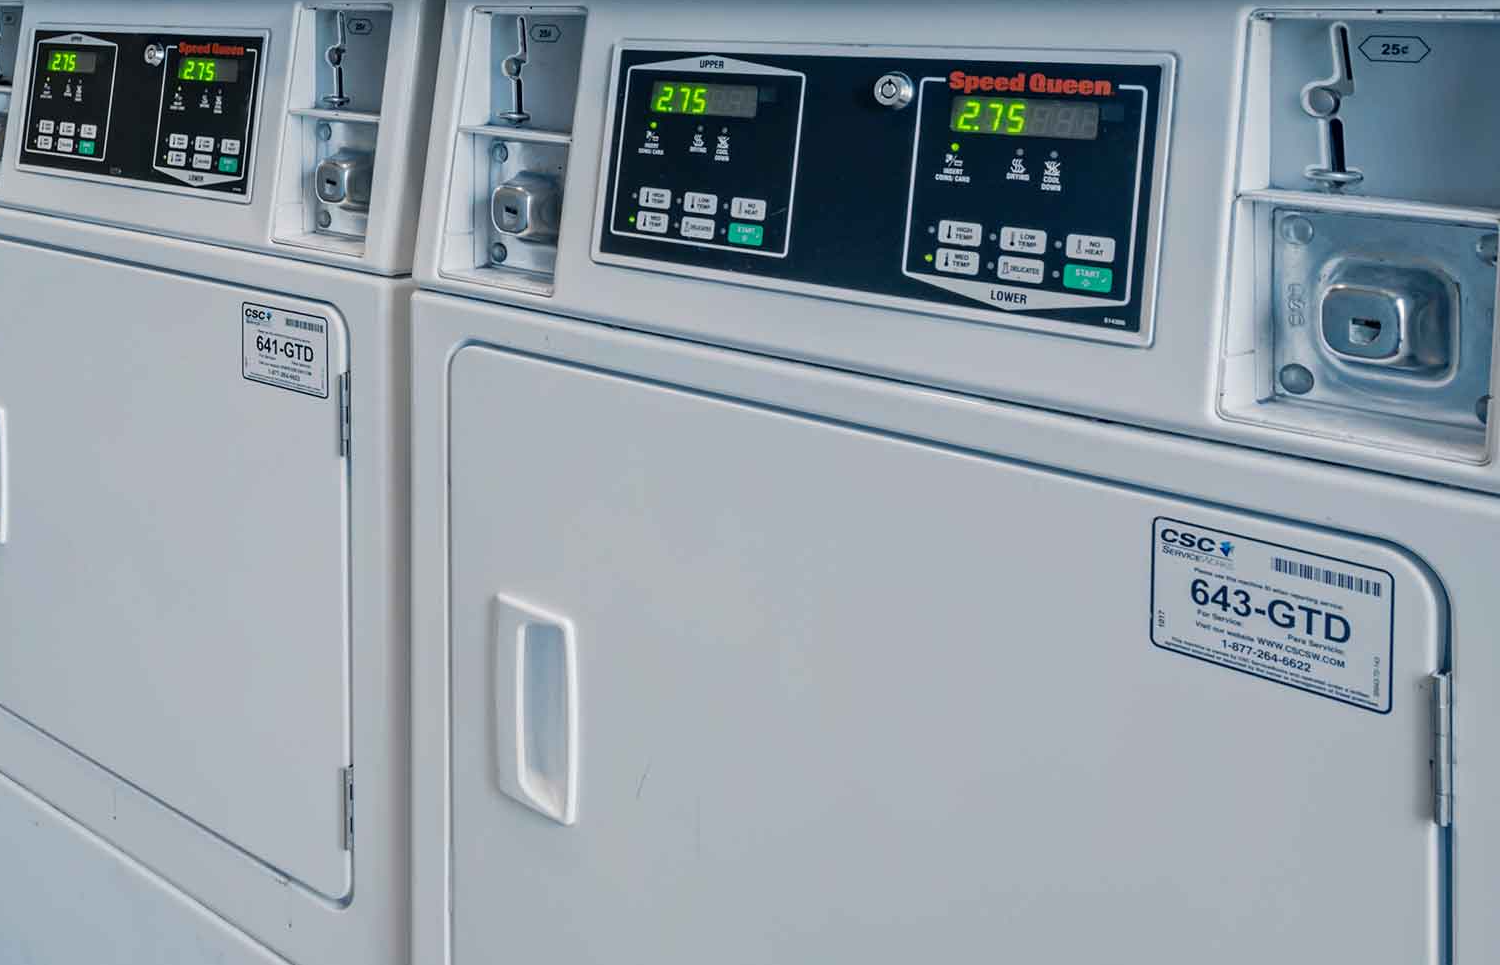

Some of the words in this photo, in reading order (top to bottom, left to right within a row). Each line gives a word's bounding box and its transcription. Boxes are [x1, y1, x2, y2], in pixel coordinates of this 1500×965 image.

[1381, 43, 1409, 56] 25¢
[183, 61, 216, 81] 2.75
[700, 60, 724, 69] UPPER
[949, 71, 1025, 94] Speed
[1029, 73, 1112, 96] Queen
[656, 86, 707, 113] 2.75
[957, 101, 1025, 133] 2.75
[1085, 248, 1104, 256] HEAT
[1075, 269, 1100, 278] START
[990, 290, 1028, 305] LOWER
[245, 308, 265, 320] CSC
[256, 335, 313, 362] 641-GTD
[1161, 529, 1216, 552] CSC
[1191, 579, 1351, 643] 643-GTD
[1221, 639, 1311, 673] 1-877-264-6622
[1257, 637, 1345, 668] WWW.CSCSW.COM
